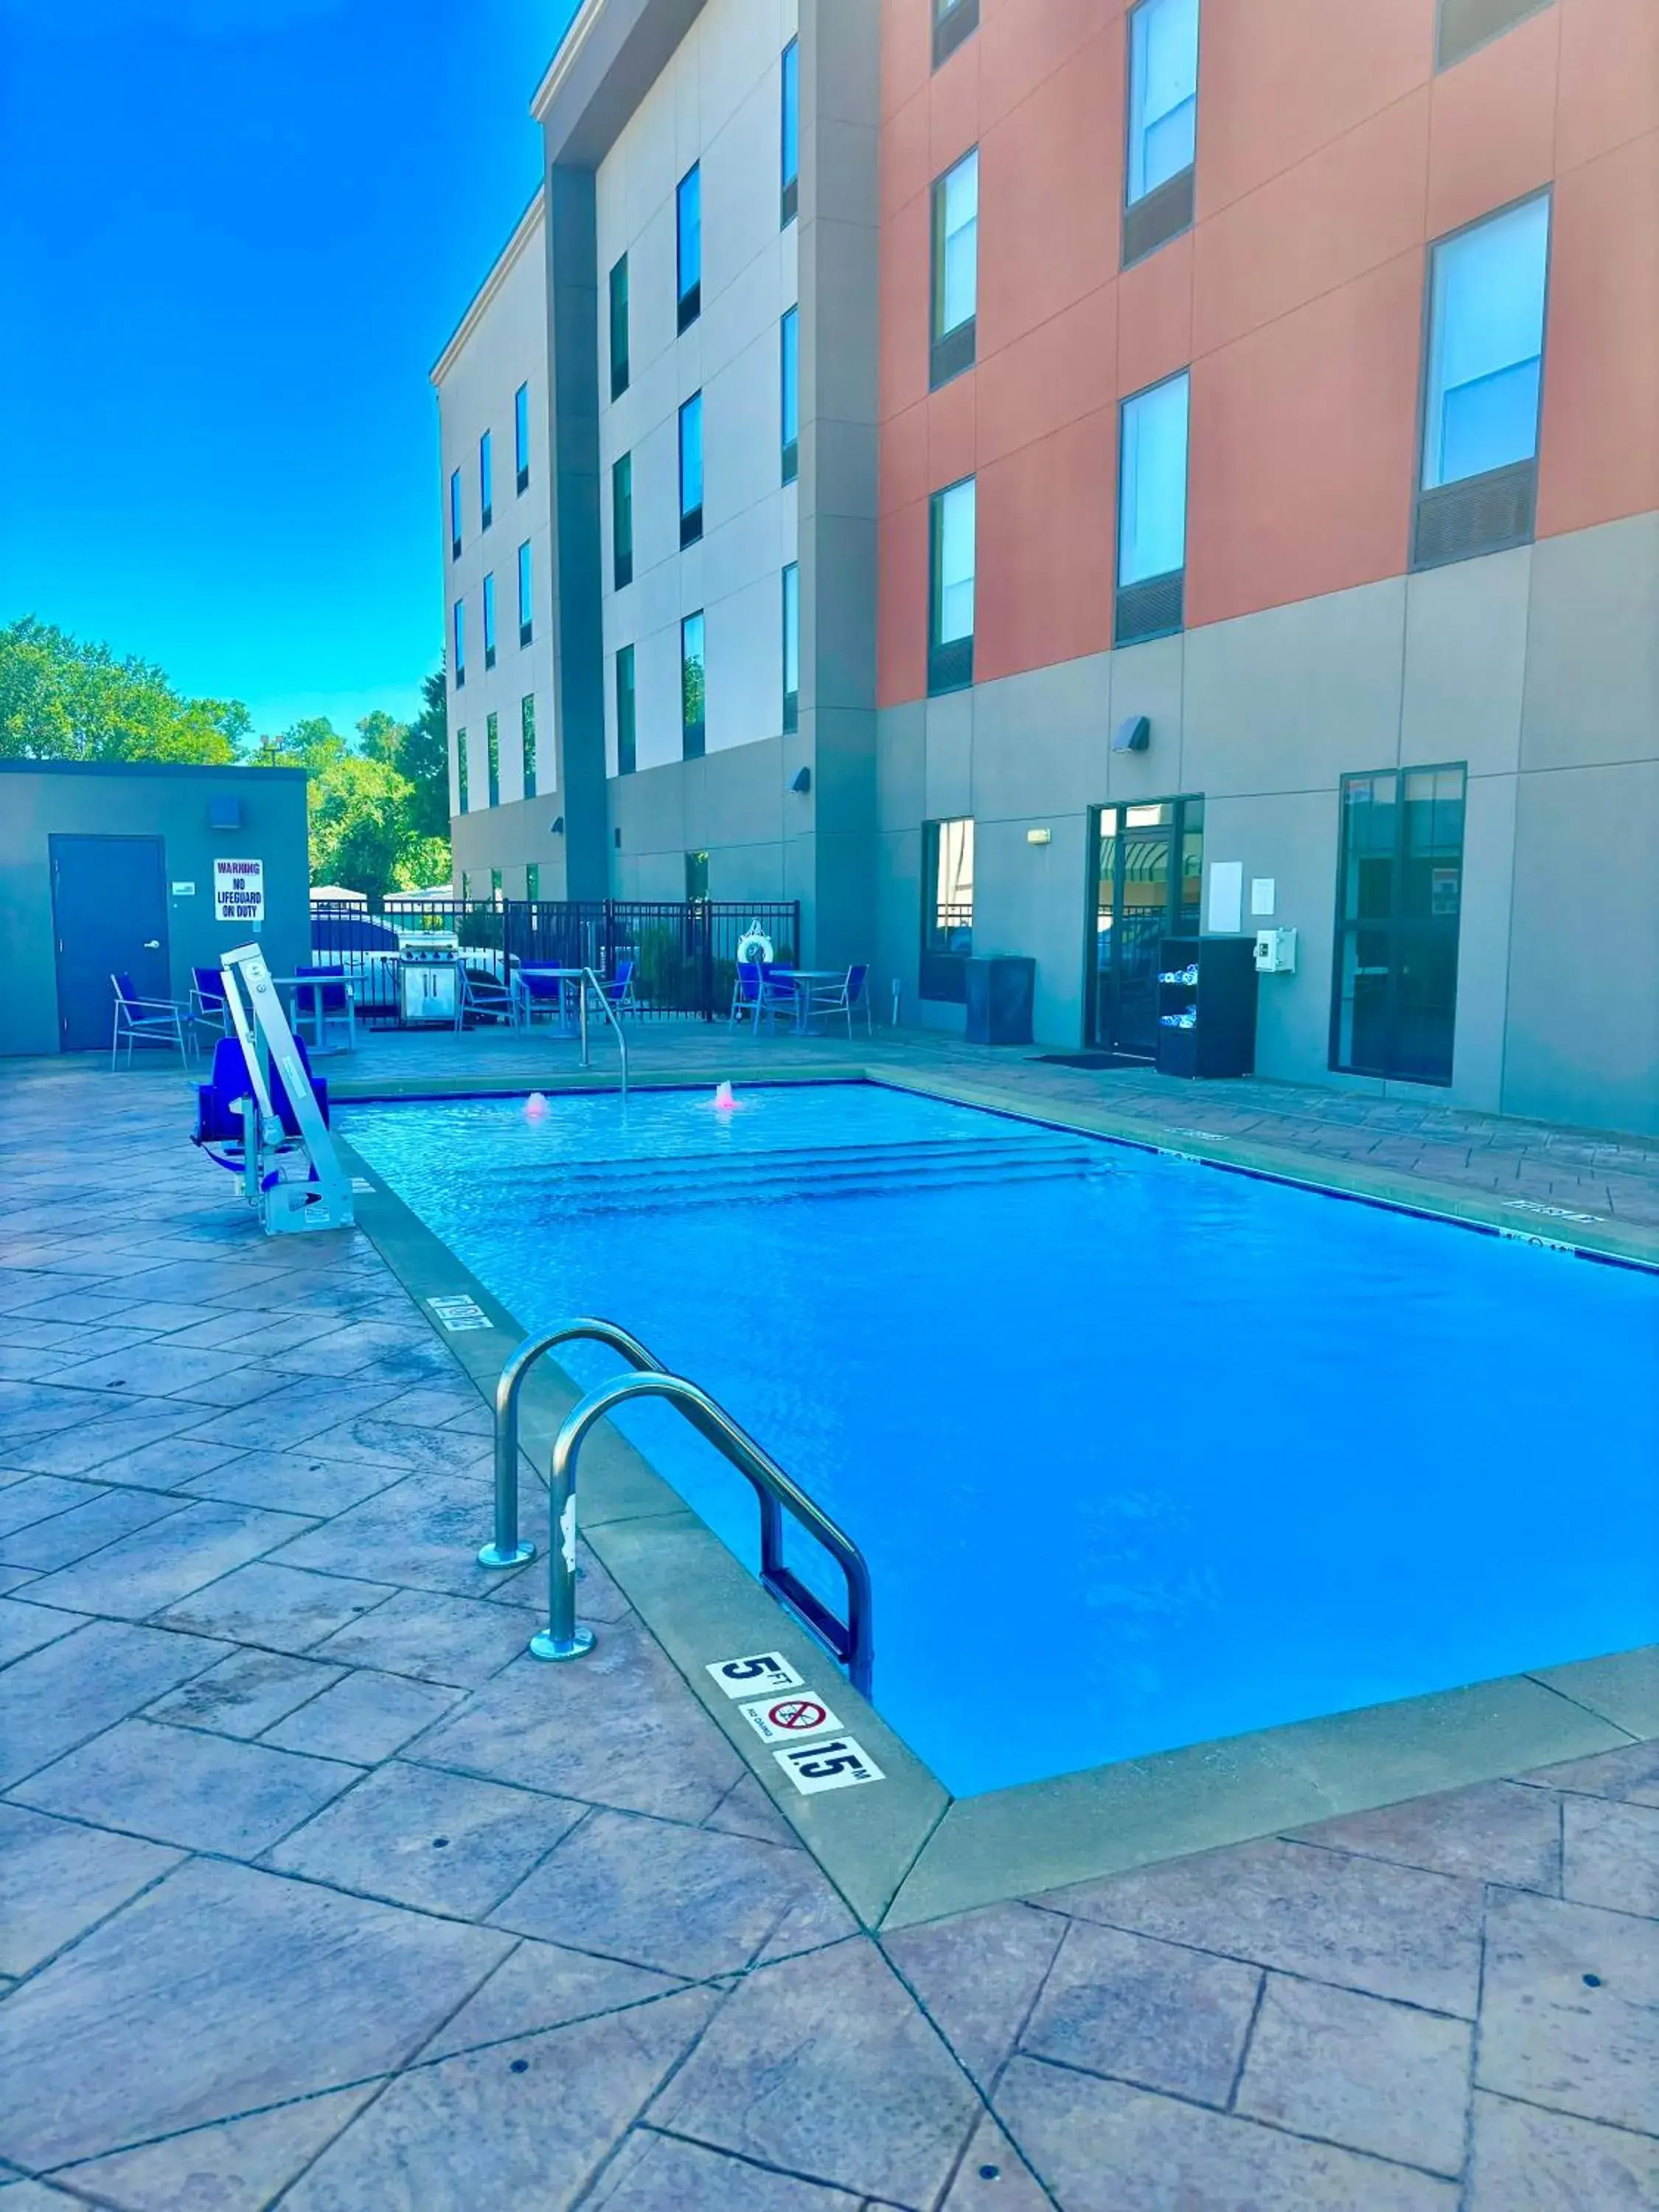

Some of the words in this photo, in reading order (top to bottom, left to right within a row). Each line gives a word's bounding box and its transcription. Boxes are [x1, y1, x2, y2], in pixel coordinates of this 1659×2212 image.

[218, 862, 260, 875] WARNING
[233, 878, 246, 890] NO
[218, 891, 262, 904] LIFEGUARD
[223, 905, 234, 917] ON
[237, 905, 257, 917] DUTY
[722, 1656, 781, 1679] 5
[767, 1672, 793, 1685] FT
[746, 1708, 758, 1717] NO
[787, 1742, 863, 1778] 1.5
[850, 1769, 872, 1781] M
